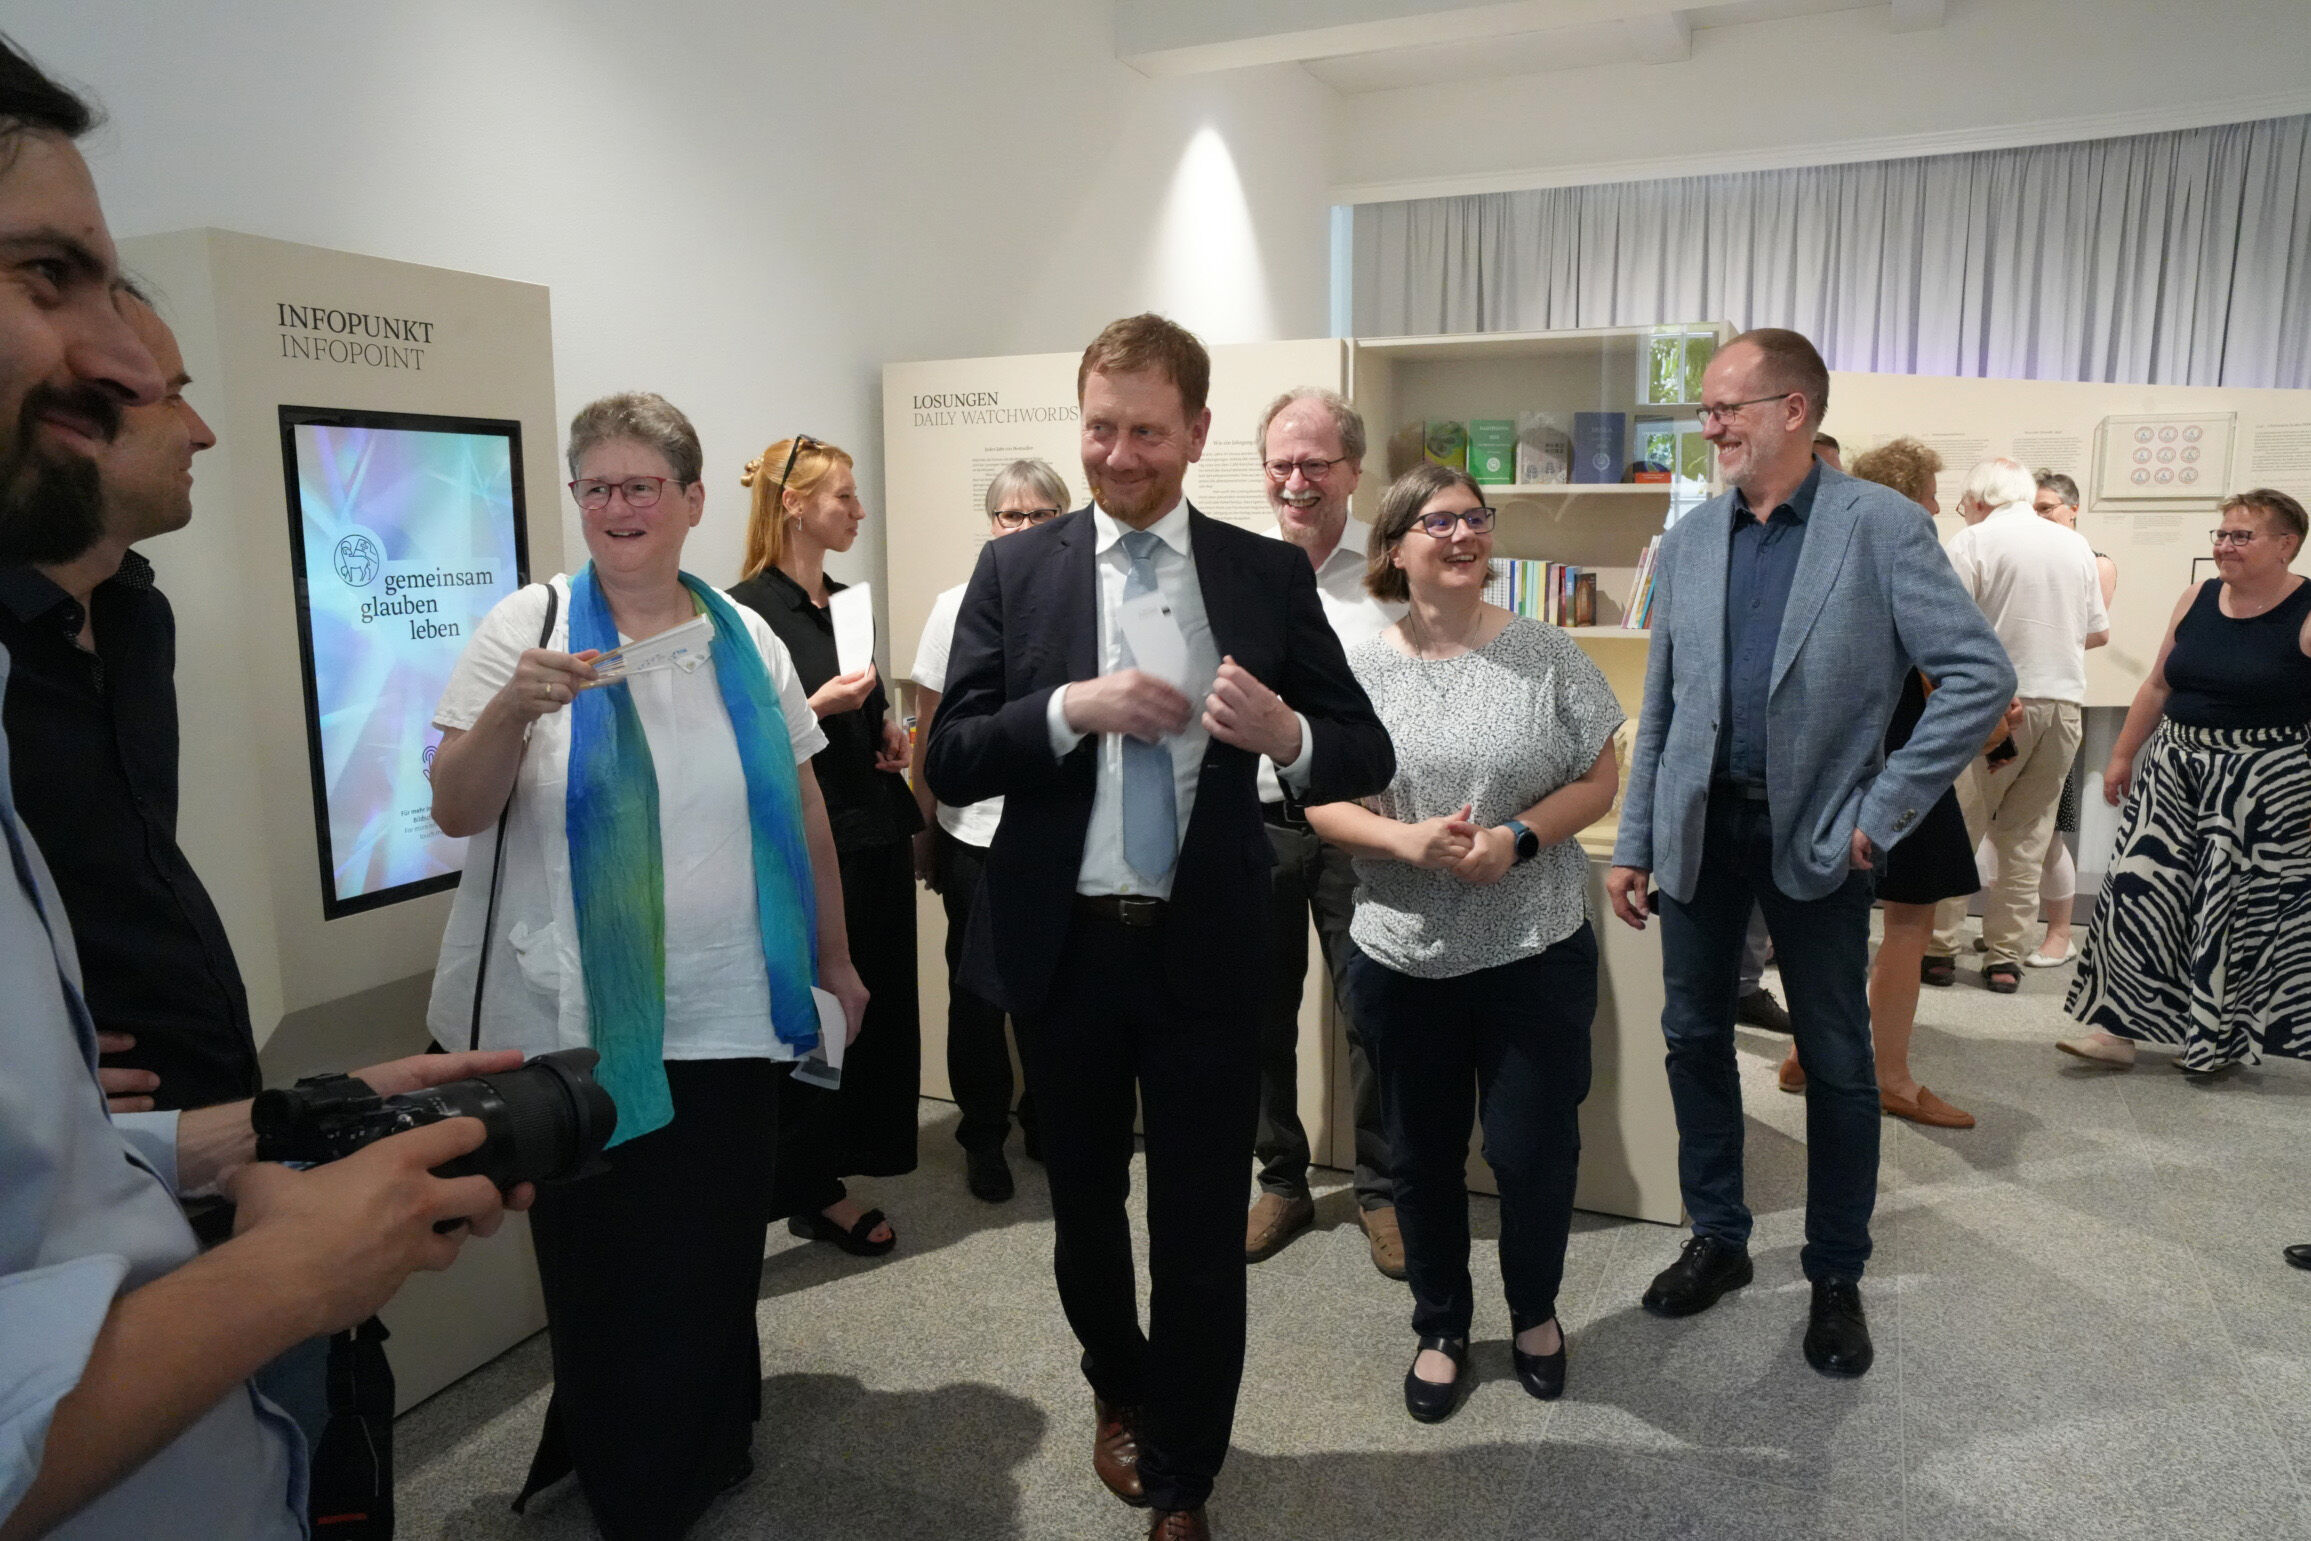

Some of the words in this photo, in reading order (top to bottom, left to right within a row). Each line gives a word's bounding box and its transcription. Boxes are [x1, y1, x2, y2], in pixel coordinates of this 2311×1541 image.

[276, 303, 434, 344] INFOPUNKT
[280, 334, 425, 370] INFOPOINT
[913, 391, 999, 409] LOSUNGEN
[914, 411, 957, 427] DAILY
[961, 406, 1079, 425] WATCHWORDS
[384, 567, 494, 596] gemeinsam
[361, 594, 439, 624] glauben
[409, 618, 461, 640] leben
